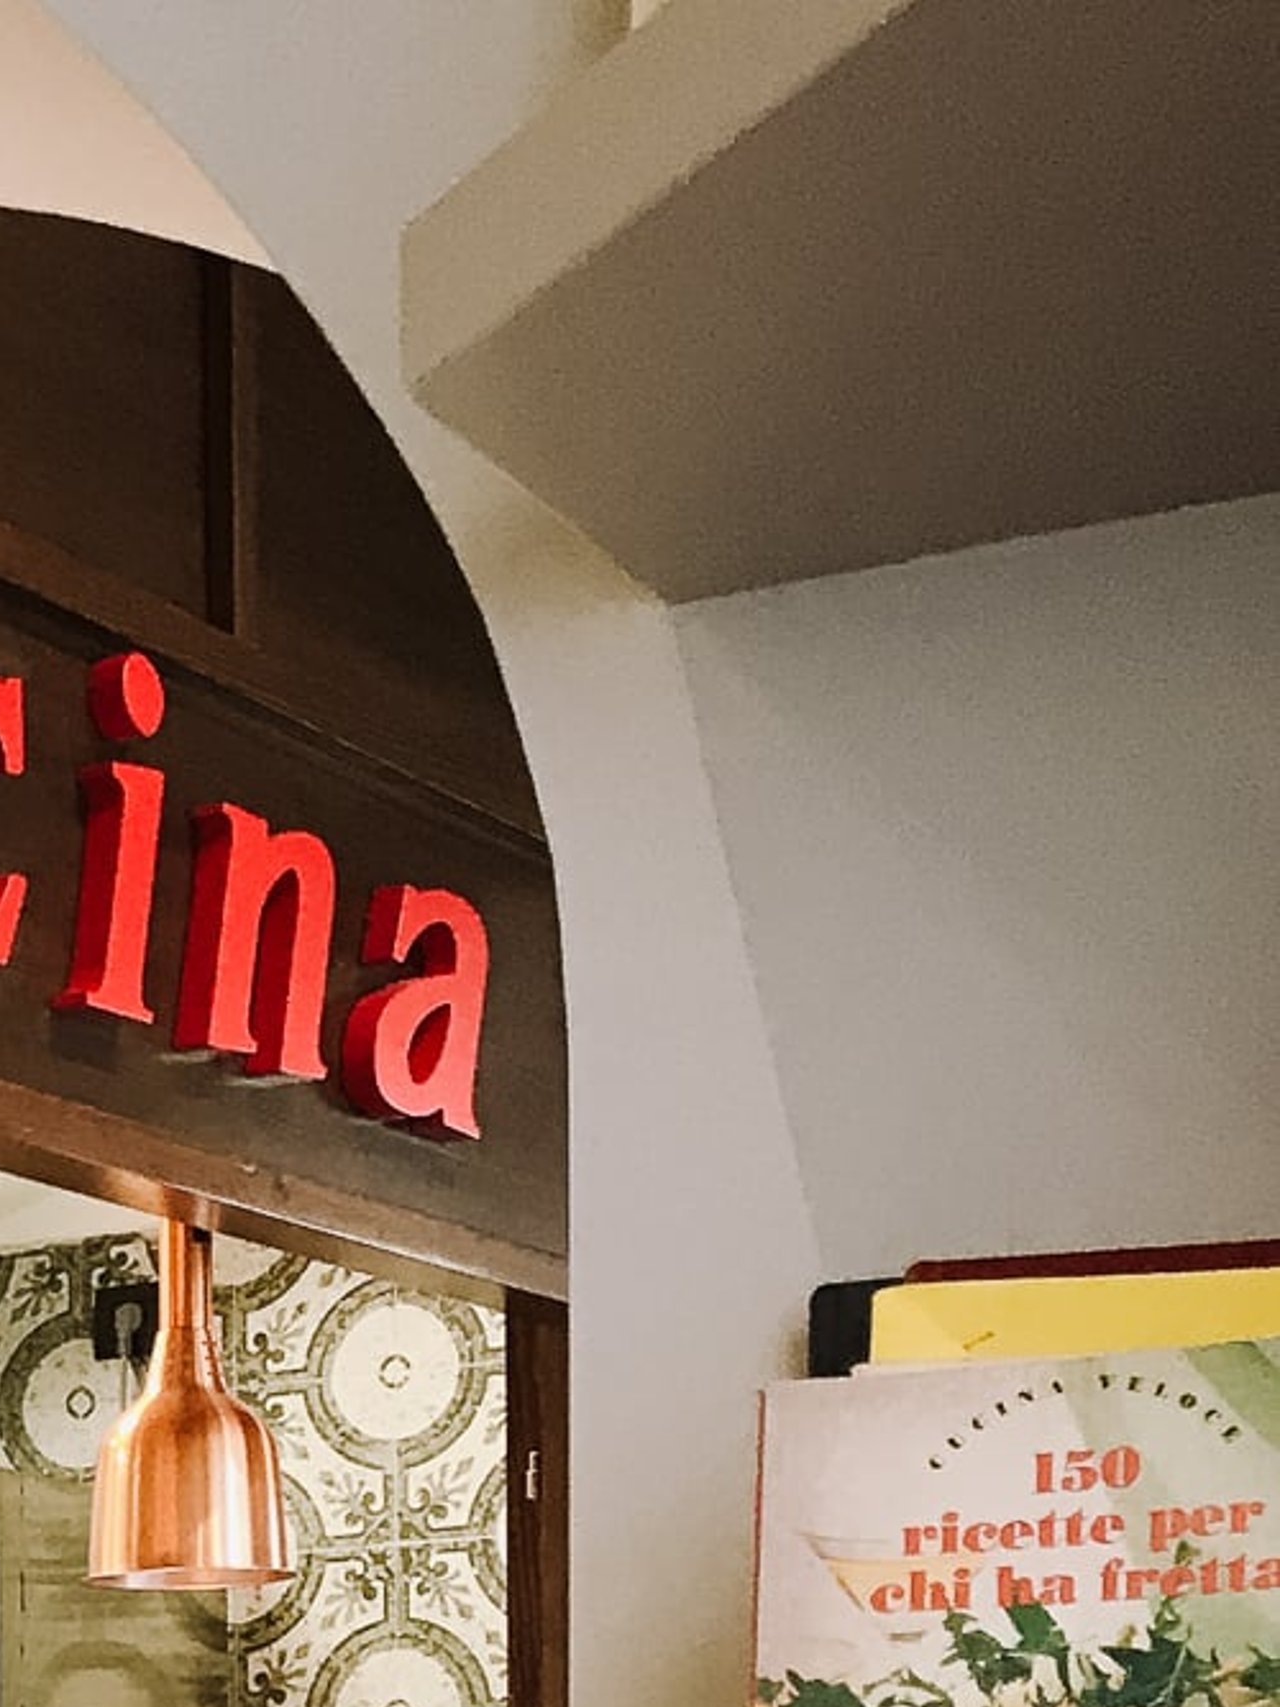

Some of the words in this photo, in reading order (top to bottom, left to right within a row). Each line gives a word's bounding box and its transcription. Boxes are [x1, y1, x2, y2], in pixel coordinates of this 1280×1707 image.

[927, 1378, 1065, 1471] CUCINA
[1097, 1373, 1242, 1445] VELOCE
[1033, 1444, 1141, 1495] 150
[902, 1509, 1127, 1556] ricette
[1146, 1500, 1268, 1553] per
[869, 1567, 972, 1614] chi
[995, 1565, 1077, 1607] ha
[1099, 1554, 1280, 1602] fretta
